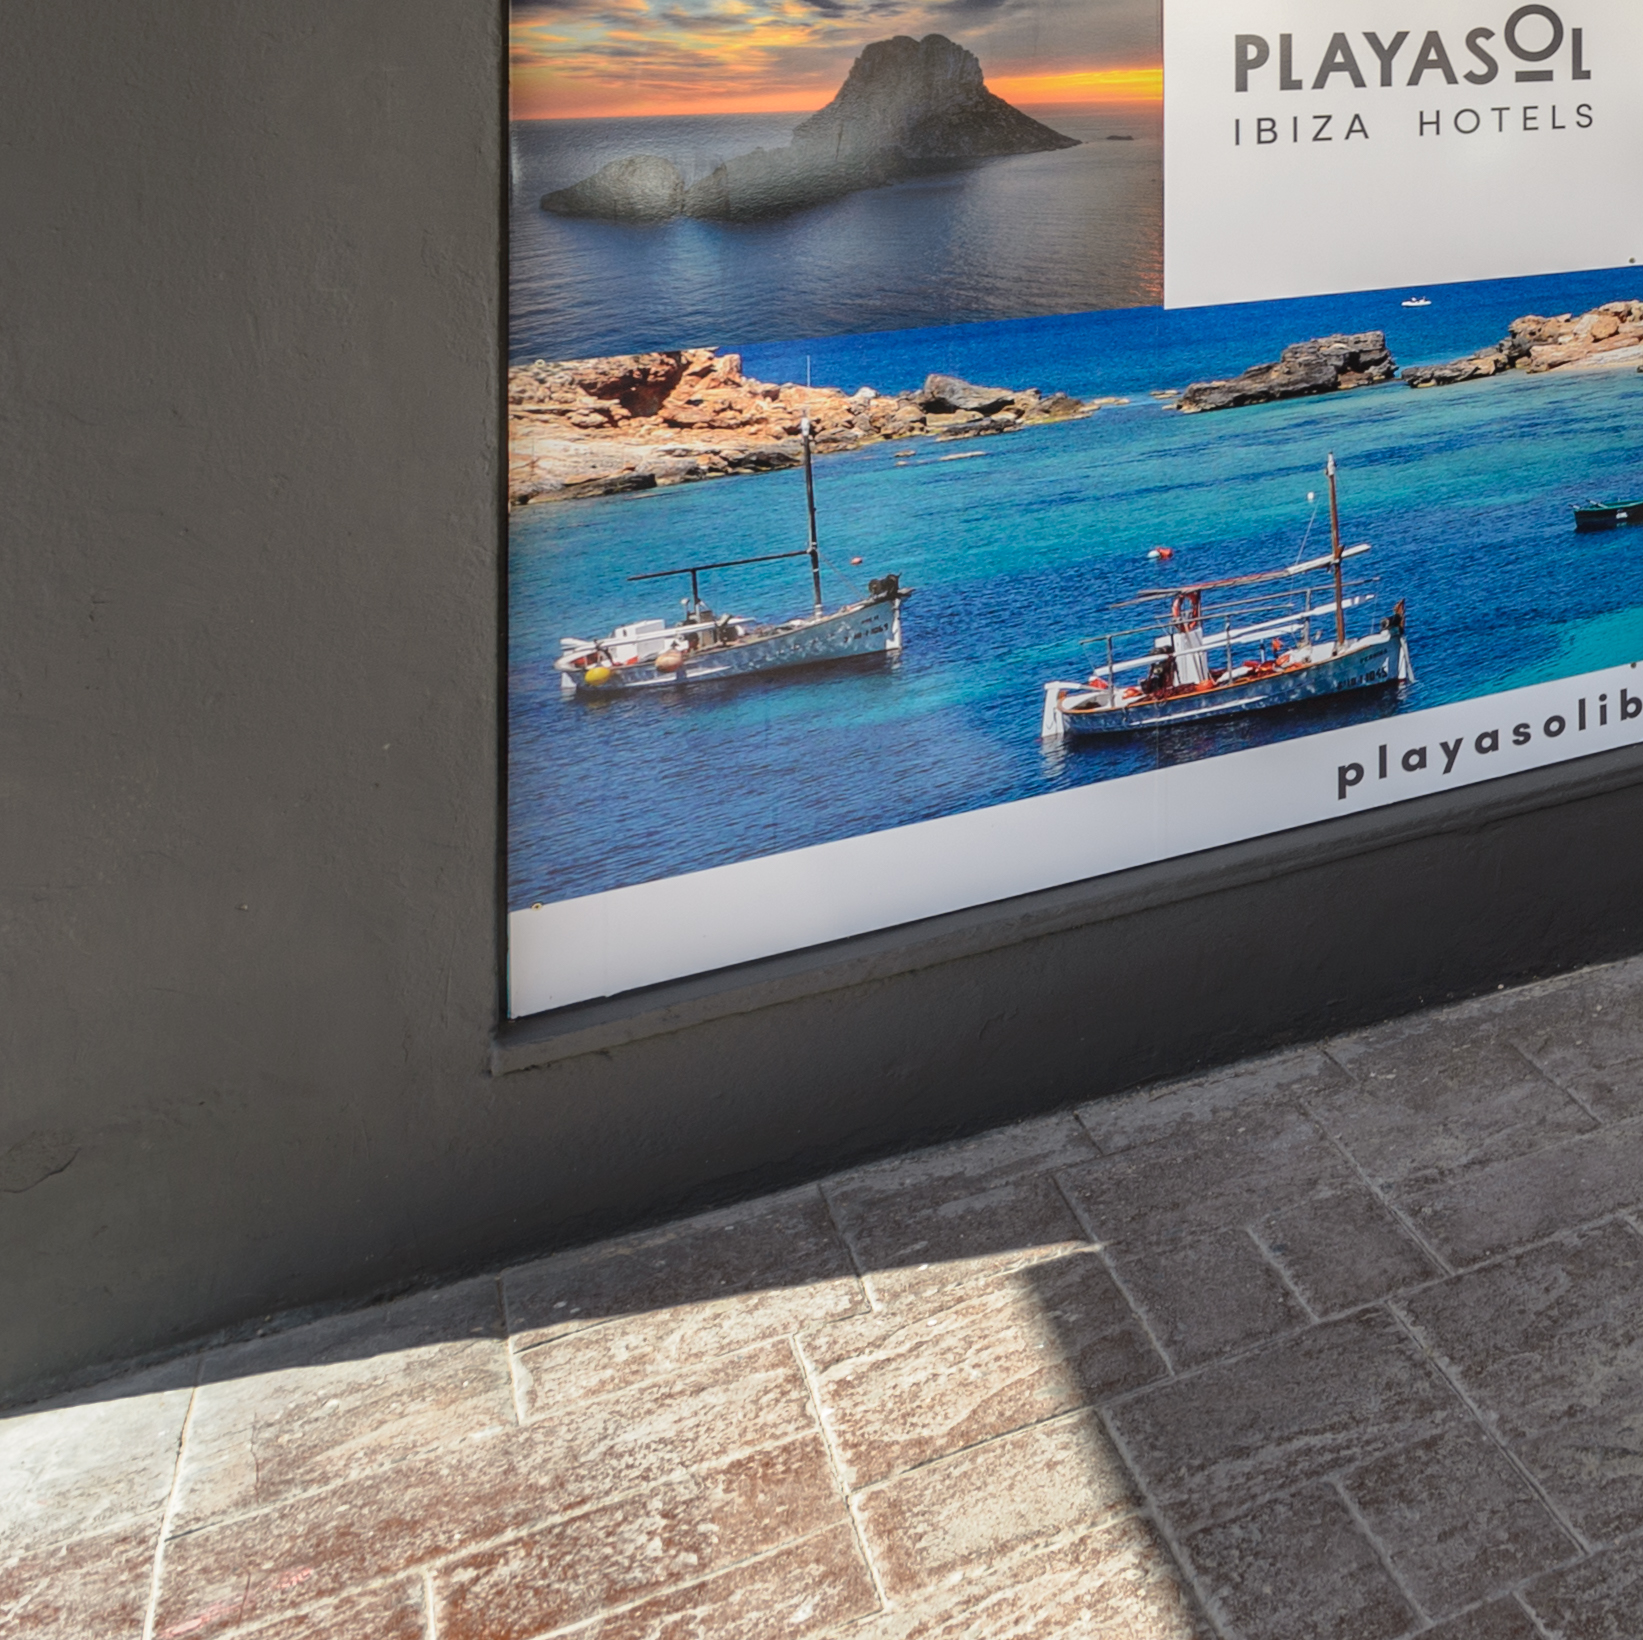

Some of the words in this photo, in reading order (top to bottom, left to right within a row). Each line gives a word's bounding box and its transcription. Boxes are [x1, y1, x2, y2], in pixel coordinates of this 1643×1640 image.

[1235, 3, 1592, 93] PLAYASOL
[1235, 114, 1369, 146] IBIZA
[1419, 103, 1593, 137] HOTELS
